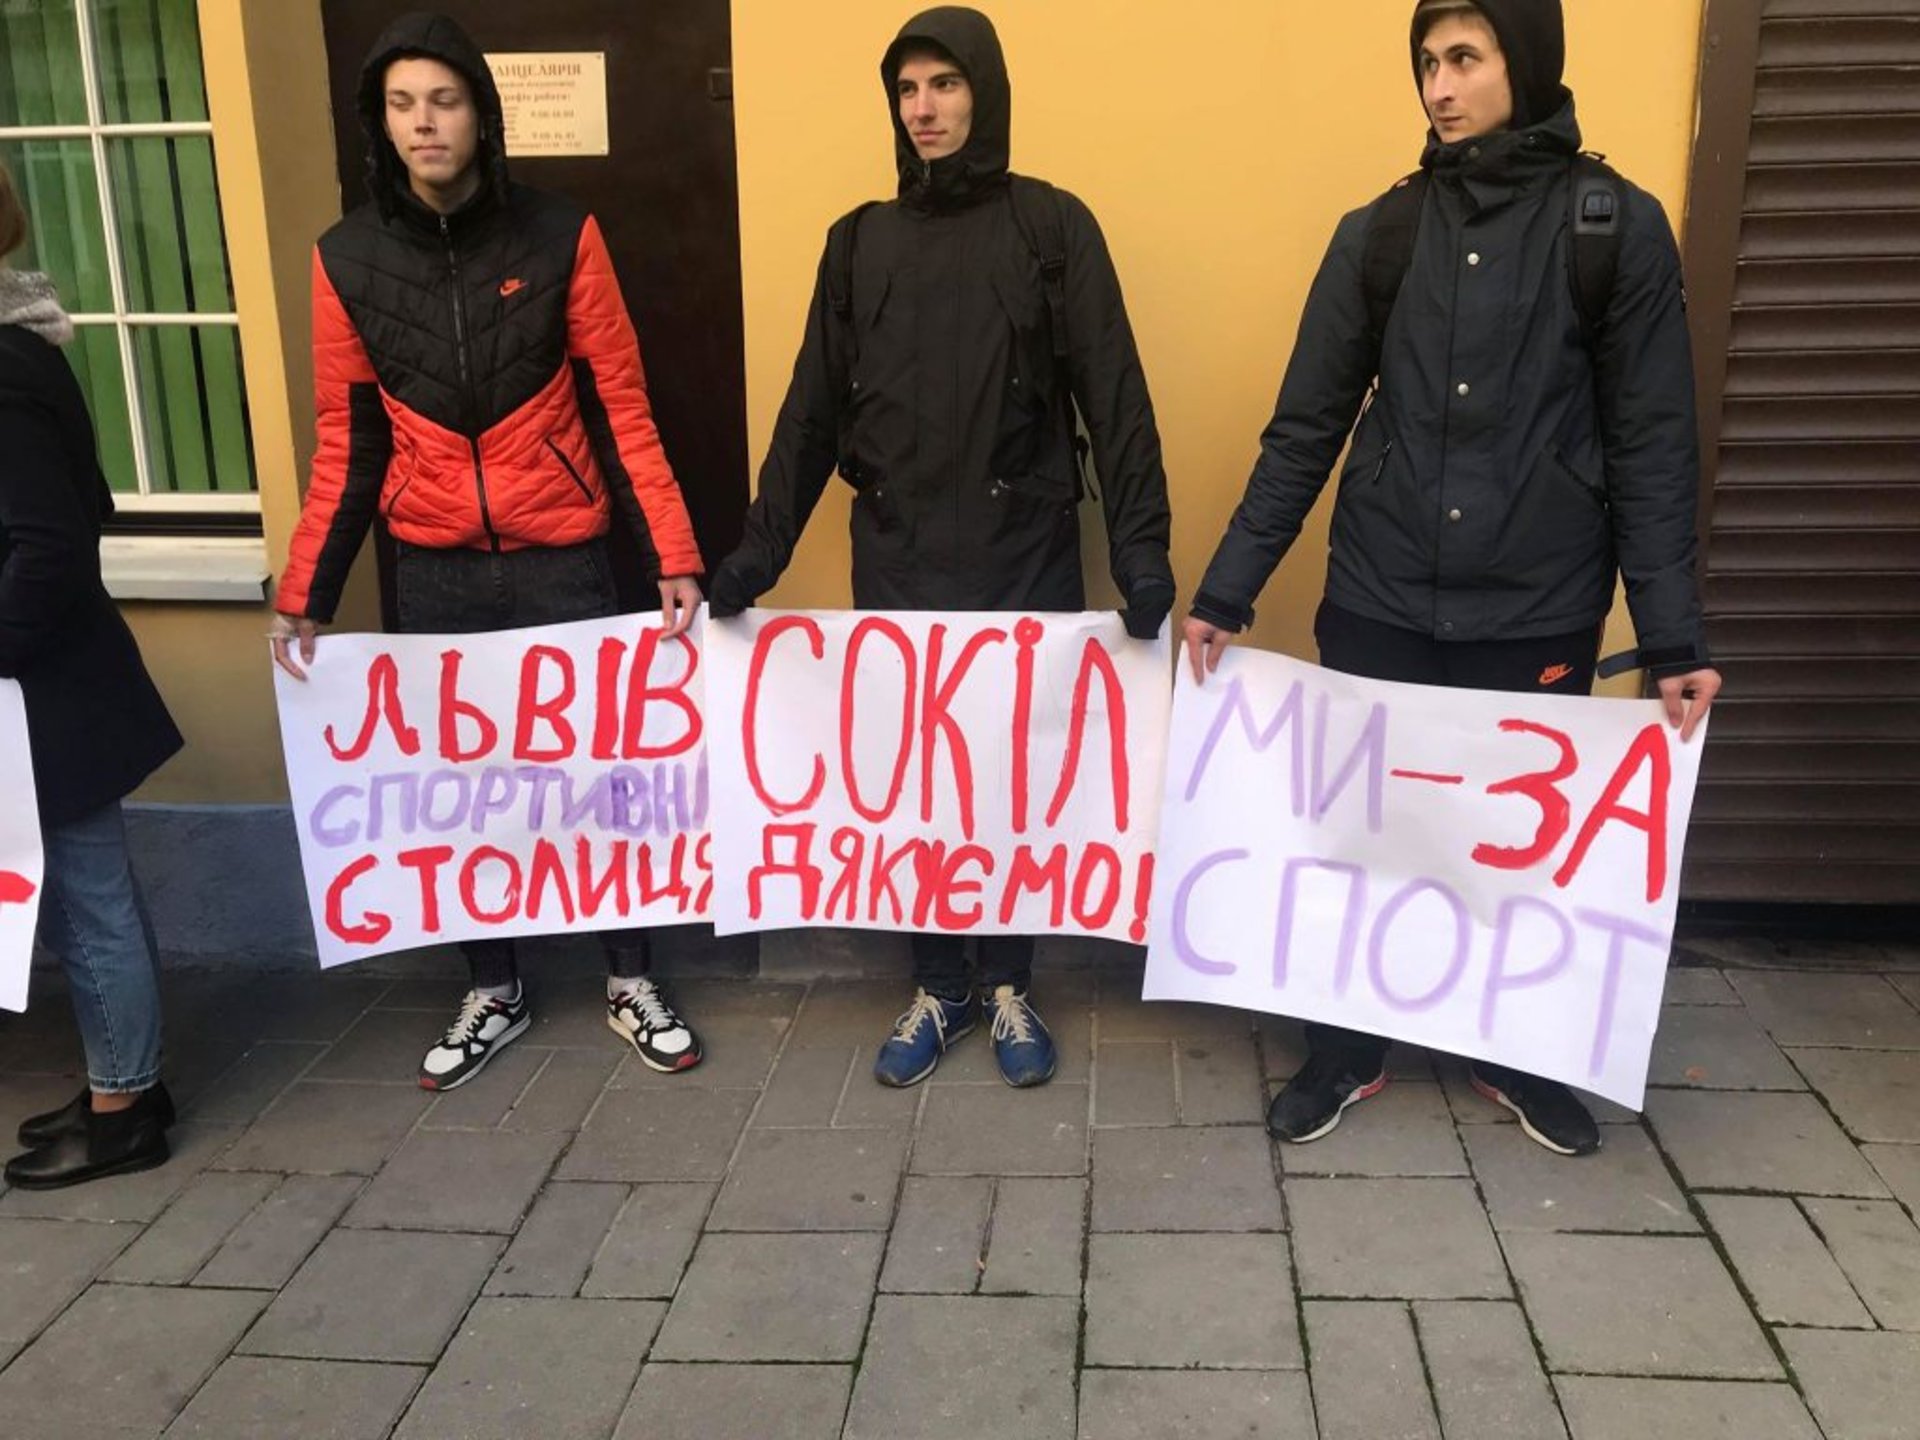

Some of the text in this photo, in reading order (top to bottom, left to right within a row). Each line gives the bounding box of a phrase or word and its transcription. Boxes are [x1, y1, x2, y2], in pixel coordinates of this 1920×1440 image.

[495, 64, 582, 78] АНЦЕЛЯРІЯ
[324, 627, 704, 763] ЛЬВІВ
[742, 615, 1129, 841] СОКІЛ
[747, 823, 1155, 943] ДЯКУЄМО!
[1171, 847, 1671, 1079] СПОРТ
